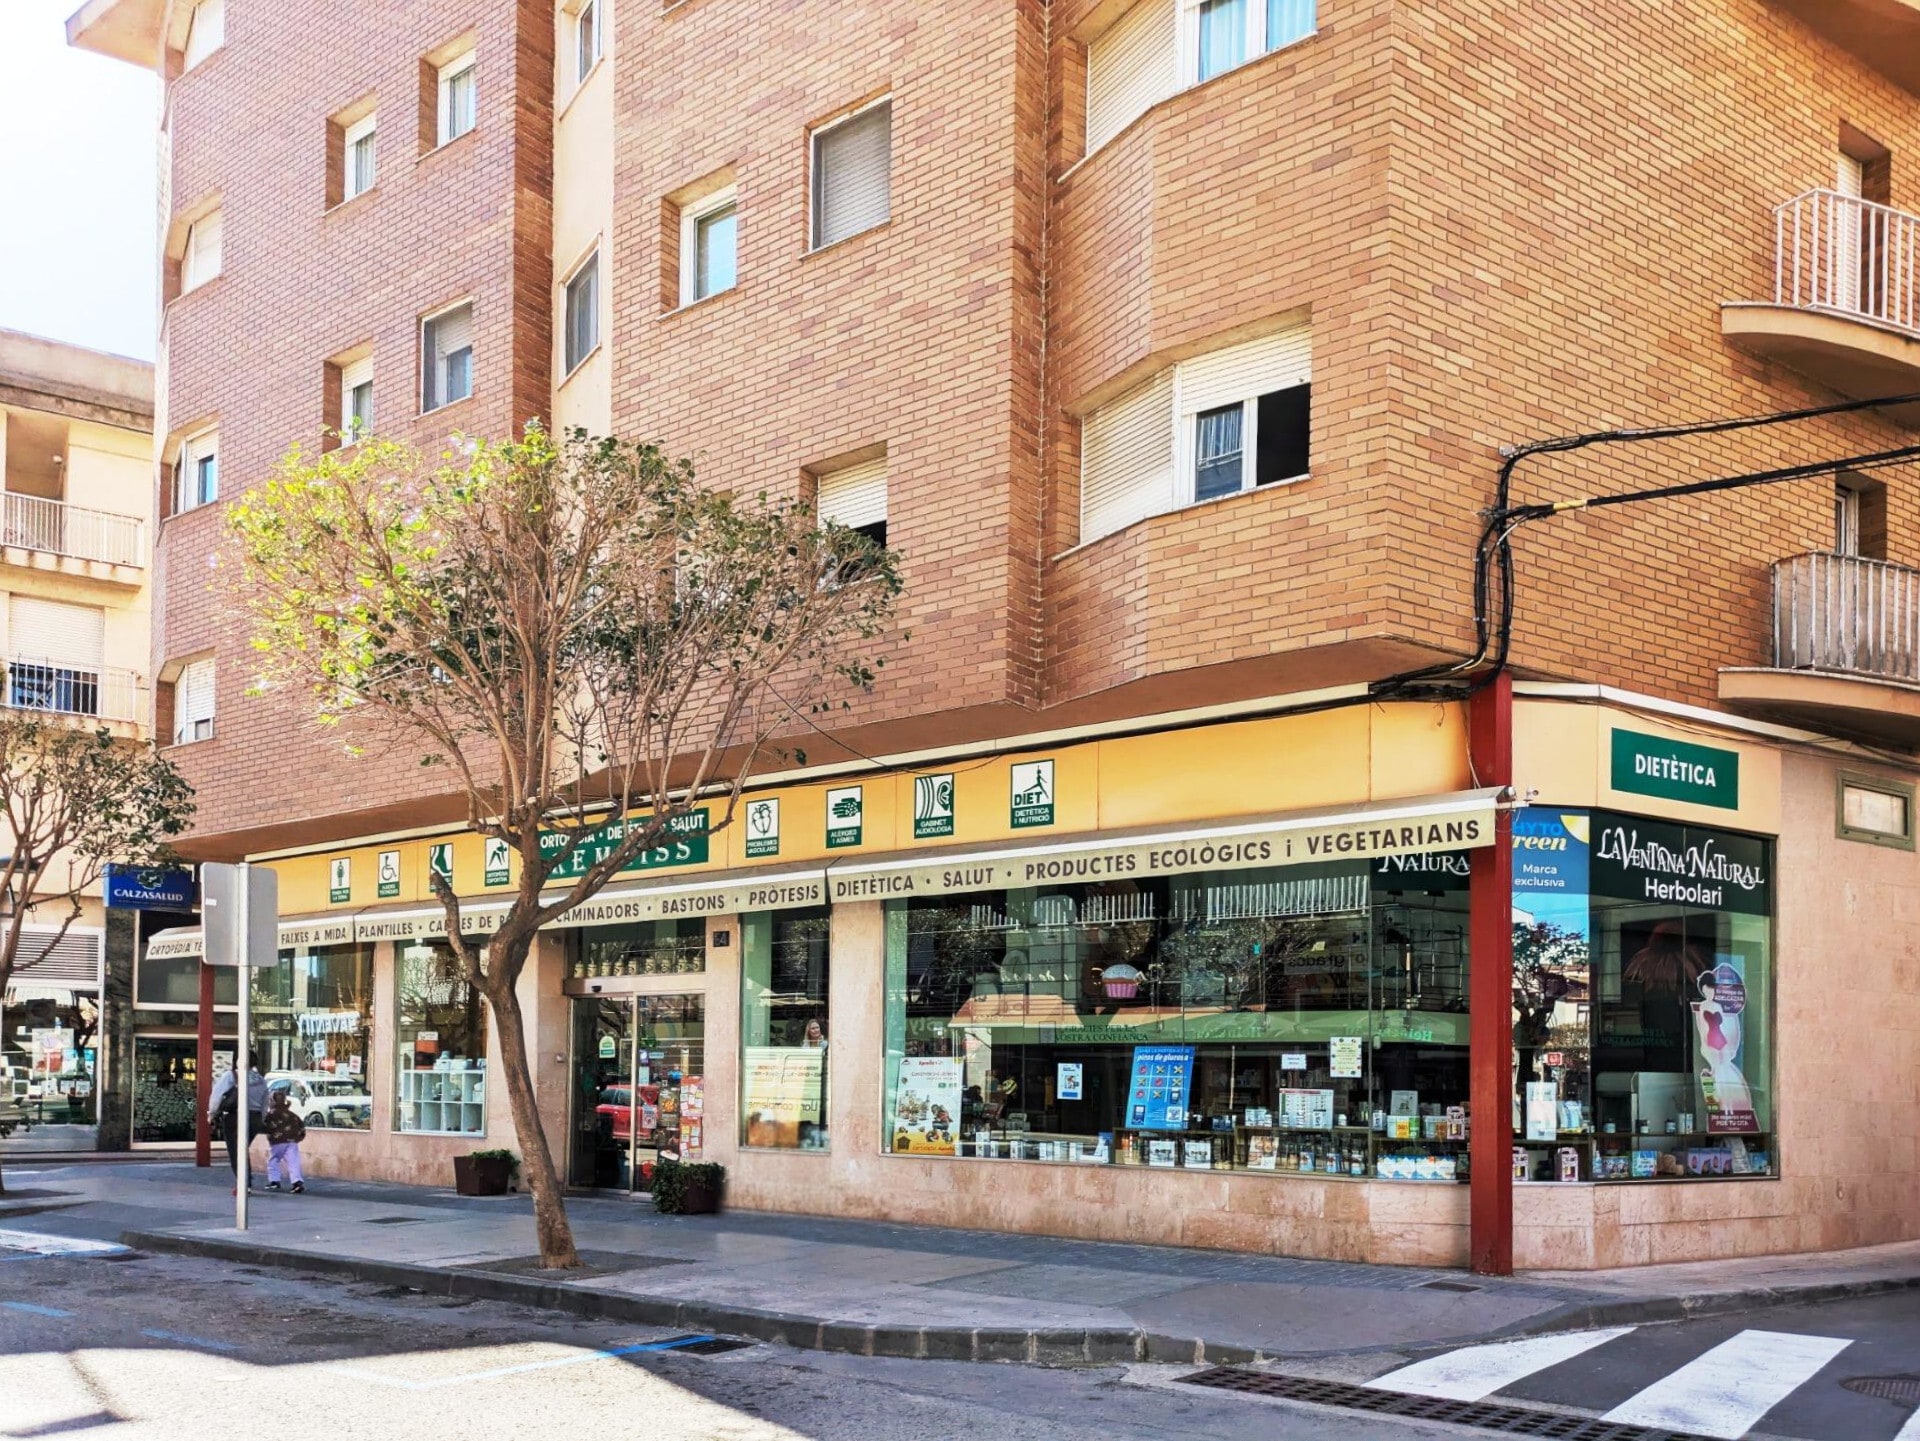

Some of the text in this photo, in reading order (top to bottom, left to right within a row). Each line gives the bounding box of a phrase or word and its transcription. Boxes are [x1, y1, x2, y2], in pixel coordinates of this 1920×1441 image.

[1634, 754, 1717, 787] DIETÈTICA
[1014, 791, 1043, 806] DIET
[920, 818, 947, 828] GABINET
[1512, 821, 1563, 837] HYTO
[747, 839, 777, 848] PROBLEMES
[747, 846, 777, 854] VASCULARS
[1512, 835, 1567, 851] reen
[836, 819, 1479, 897] DIETÈTICA SALUT PRODUCTES ECOLÒGICS i VEGETARIANS
[1375, 852, 1471, 877] NATURA
[1522, 863, 1558, 875] Marca
[1514, 876, 1565, 888] exclusiva
[113, 888, 184, 902] CALZASALUD
[1645, 877, 1723, 906] Herbolari
[555, 884, 819, 922] CAMINADORS BASTONS PRÒTESIS
[359, 922, 413, 938] PLANTILLES
[429, 917, 473, 933] CAES
[479, 915, 492, 928] DE
[281, 927, 347, 945] FAIXES A MIDA
